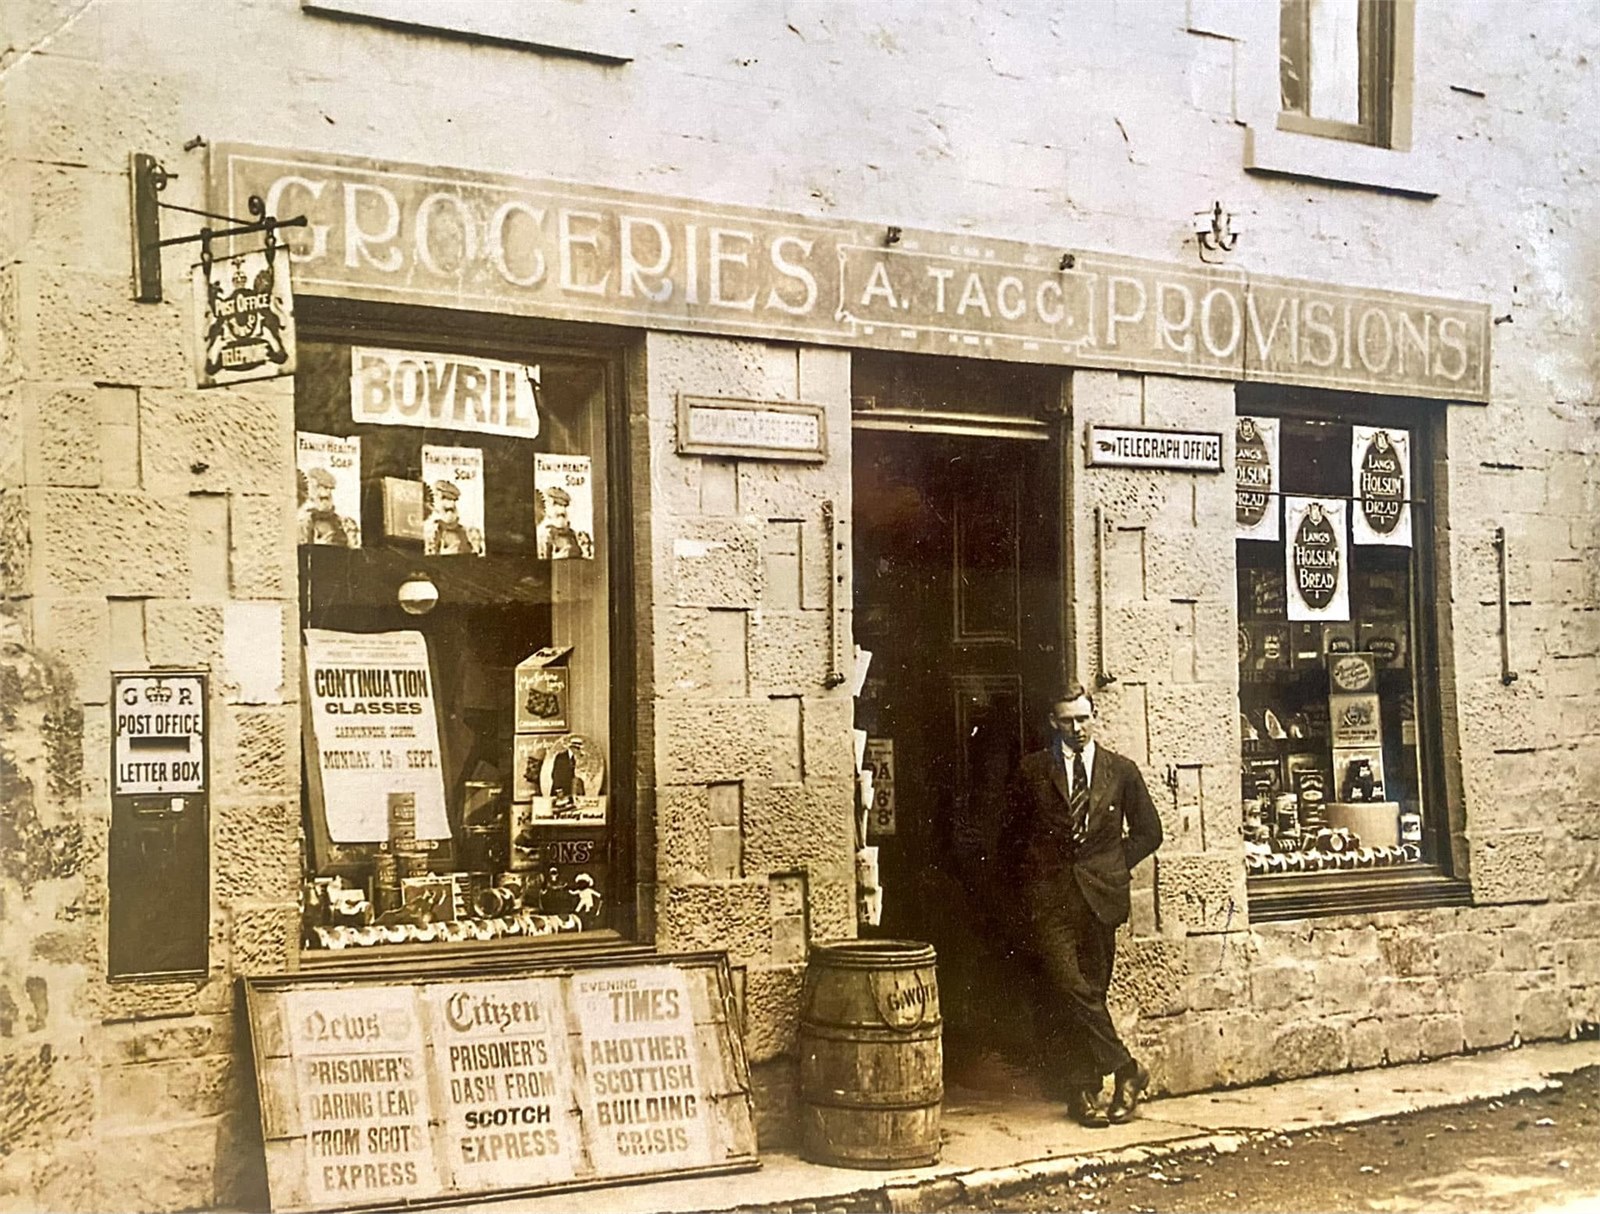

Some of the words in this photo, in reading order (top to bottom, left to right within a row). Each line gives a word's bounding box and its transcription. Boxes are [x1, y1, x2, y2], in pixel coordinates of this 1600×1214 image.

[267, 176, 819, 315] GROCERIES
[861, 262, 909, 309] A.
[236, 293, 271, 313] OFFICE
[1105, 276, 1471, 381] PROVISIONS
[360, 354, 531, 428] BOVRIL
[1116, 436, 1180, 459] TELEGRAPH
[1183, 439, 1218, 462] OFFICE
[1366, 494, 1398, 515] BREAD
[1300, 568, 1334, 589] BREAD
[178, 687, 193, 706] R
[314, 668, 429, 699] CONTINUATION
[325, 702, 422, 715] CLASSES
[118, 714, 152, 736] POST
[155, 713, 200, 735] OFFICE
[120, 762, 168, 784] LETTER
[172, 761, 200, 783] BOX
[580, 979, 637, 993] EVENING
[446, 991, 540, 1033] Citizen
[609, 988, 680, 1023] TIMES
[300, 1010, 382, 1043] News
[449, 1039, 548, 1072] PRISONER'S
[590, 1035, 688, 1066] ANOTHER
[309, 1056, 415, 1085] PRISONER'S
[593, 1064, 695, 1095] SCOTTISH
[451, 1075, 498, 1104] DASH
[505, 1071, 556, 1100] FROM
[309, 1091, 374, 1121] DARING
[378, 1088, 419, 1117] LEAP
[464, 1105, 551, 1130] SCOTCH
[596, 1094, 697, 1128] BUILDING
[312, 1127, 360, 1157] FROM
[367, 1124, 426, 1155] SCOTS
[460, 1129, 560, 1165] EXPRESS
[616, 1127, 689, 1157] CRISIS
[323, 1161, 418, 1191] EXPRESS
